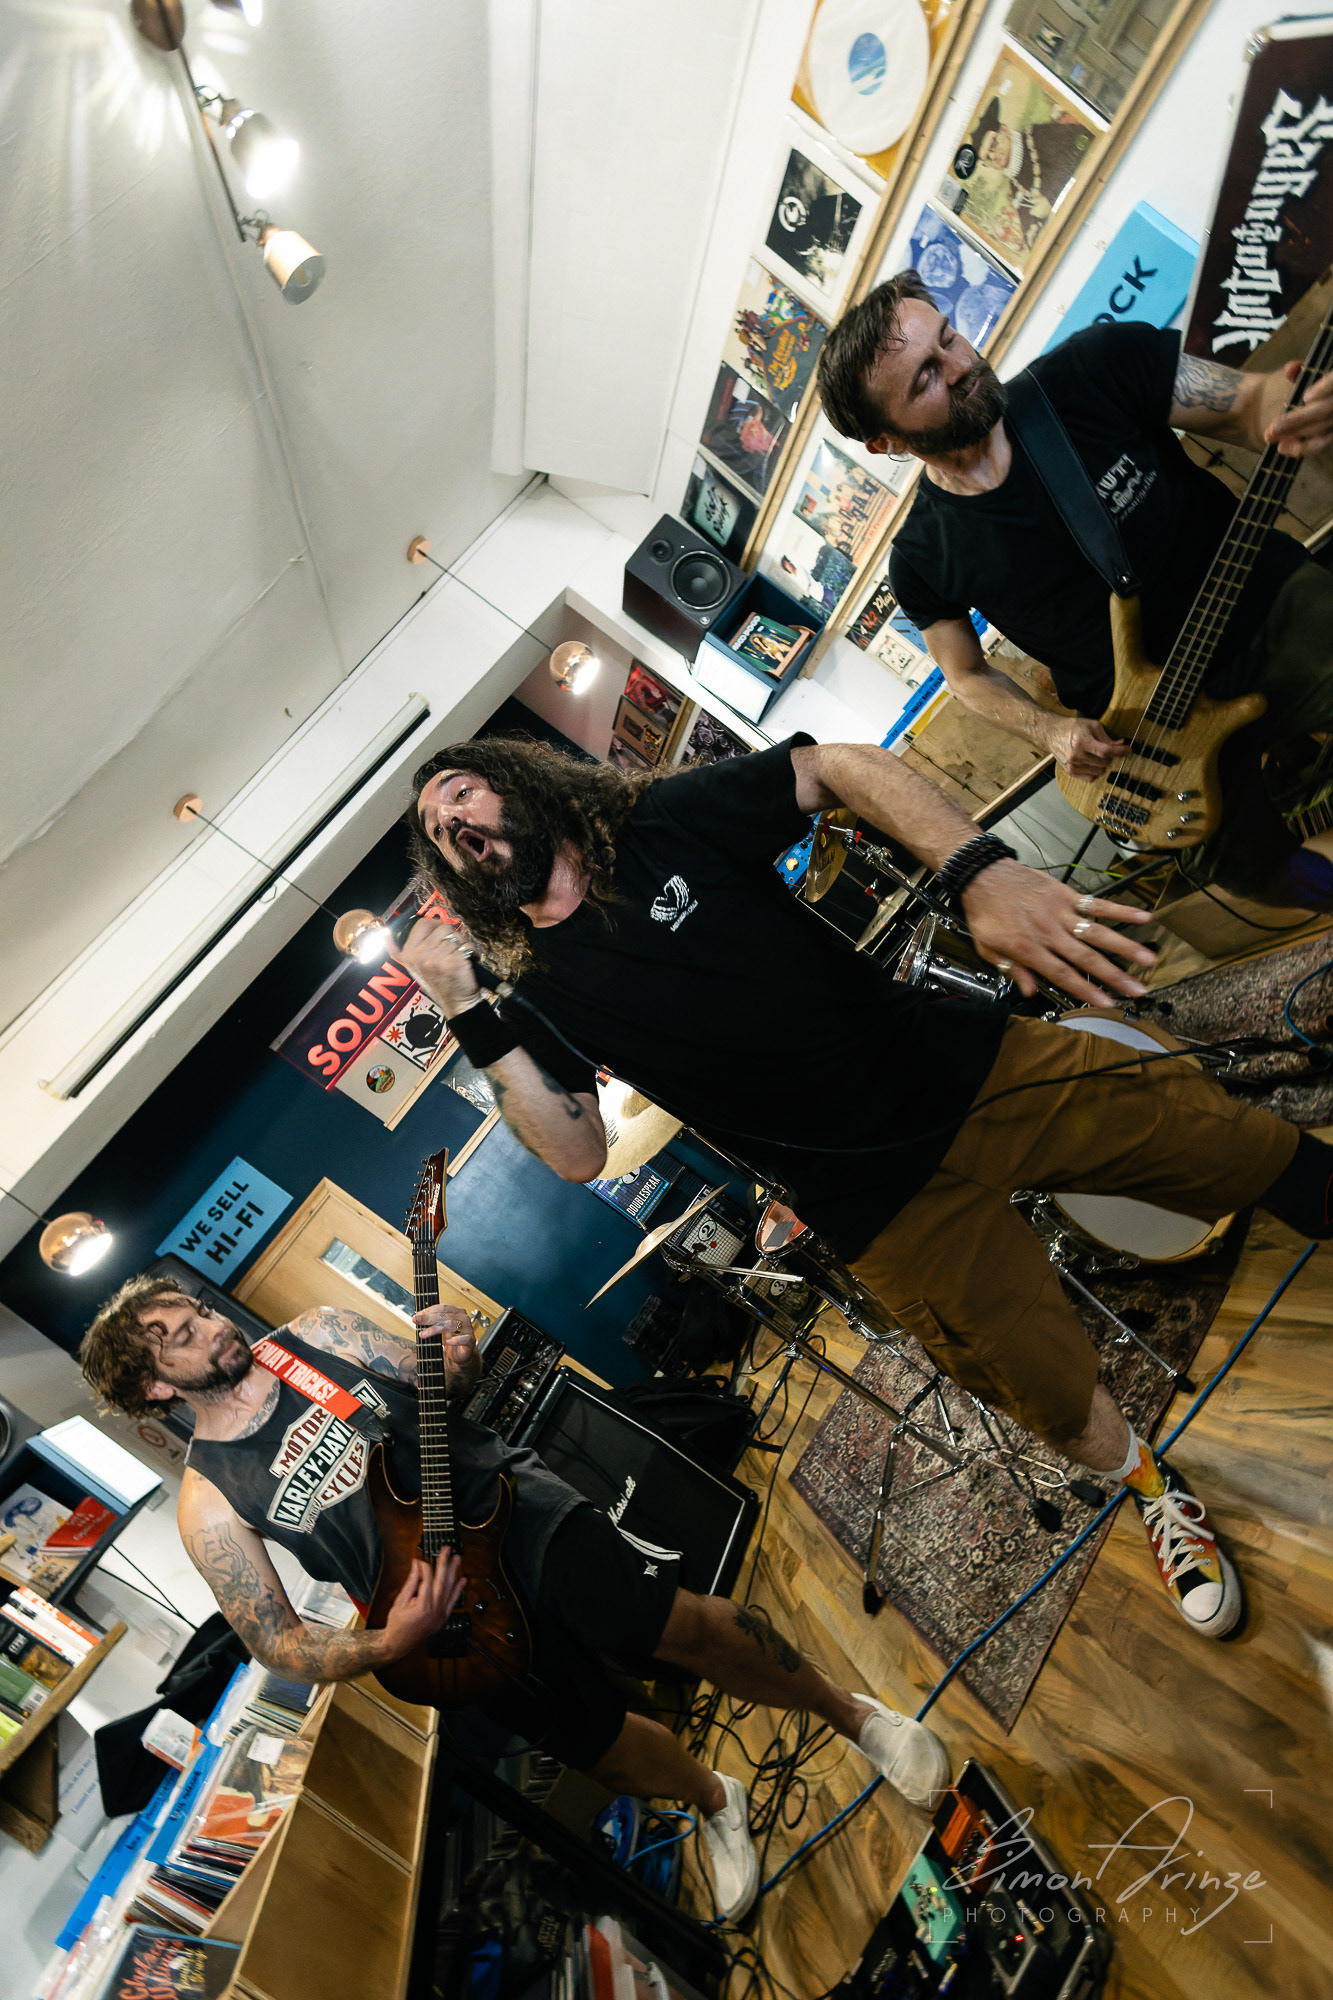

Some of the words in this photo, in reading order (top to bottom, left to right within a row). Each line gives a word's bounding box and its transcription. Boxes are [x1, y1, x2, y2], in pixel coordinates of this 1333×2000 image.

[308, 956, 412, 1076] SOUN
[179, 1220, 212, 1252] WE
[208, 1181, 249, 1221] SELL
[428, 1183, 441, 1216] Ibanez
[626, 1174, 662, 1217] DOUBLESPEAK
[205, 1200, 264, 1265] HI-FI
[701, 1224, 715, 1238] 2
[774, 1279, 785, 1292] 3
[283, 1359, 339, 1405] TRICKS!
[279, 1408, 328, 1470] MOTOR
[321, 1442, 364, 1501] CYCLES
